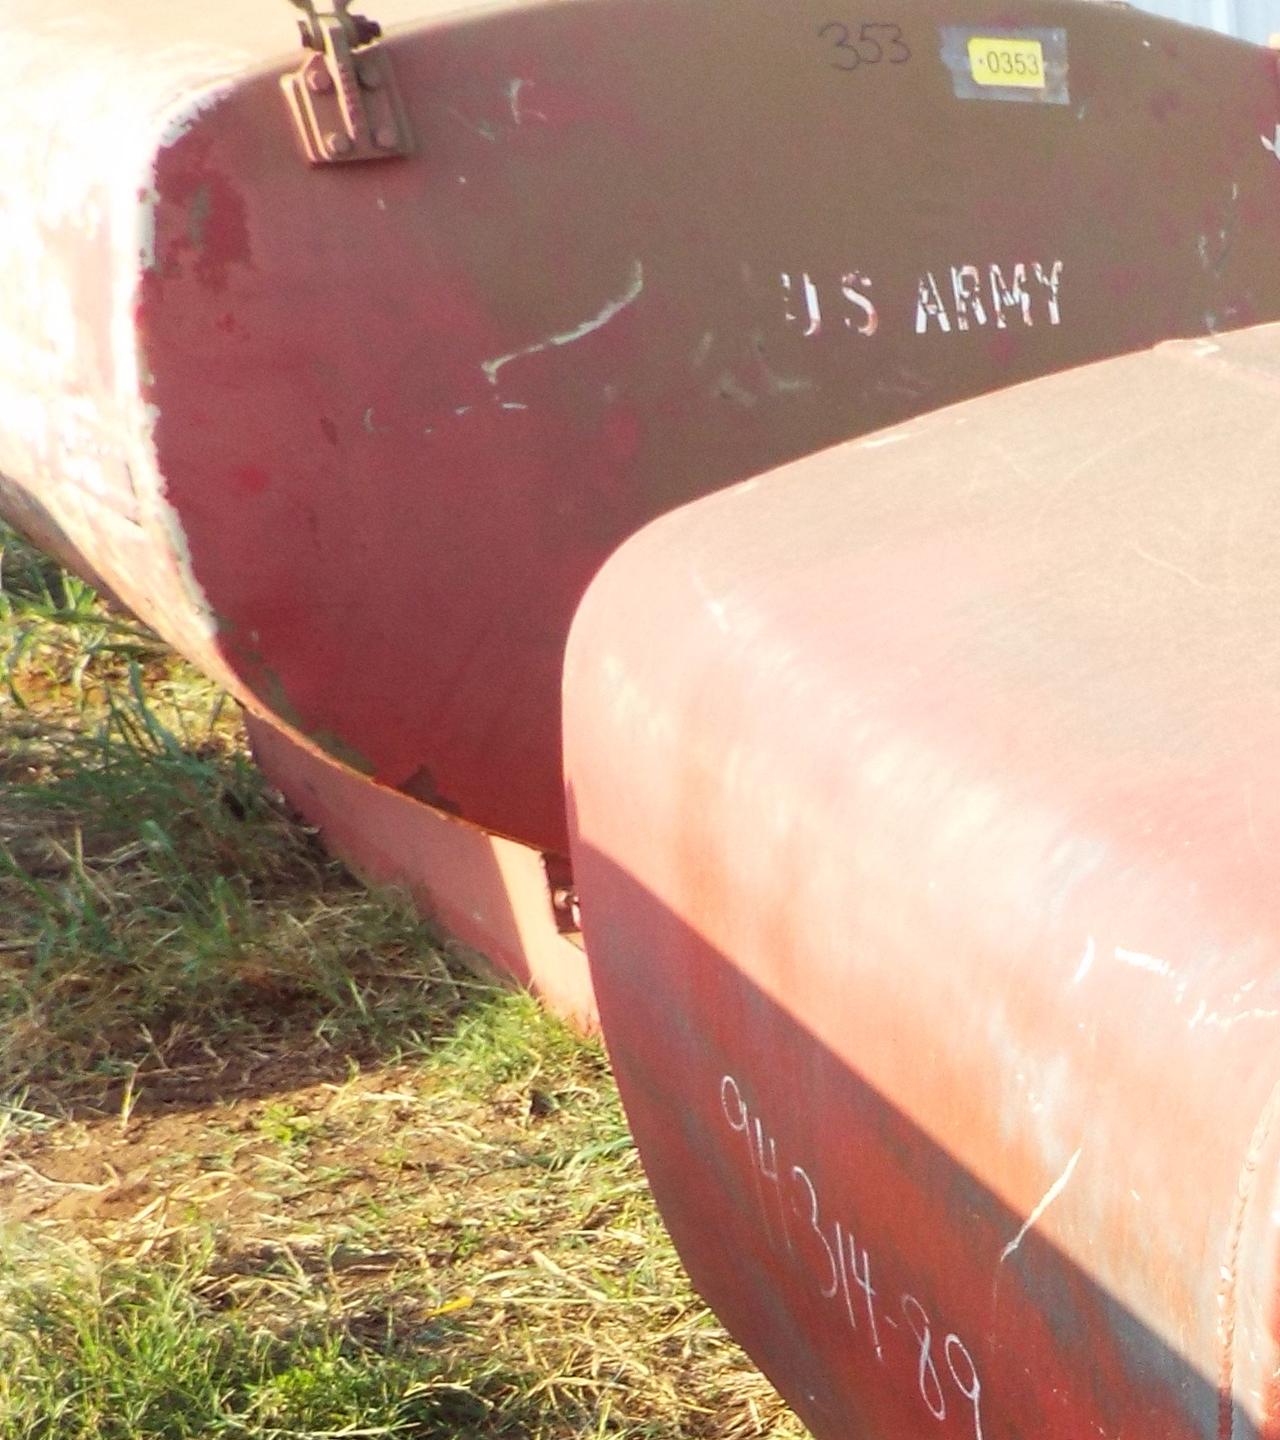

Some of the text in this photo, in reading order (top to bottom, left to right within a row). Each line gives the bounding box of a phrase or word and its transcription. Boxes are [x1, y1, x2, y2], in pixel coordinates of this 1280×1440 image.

[817, 22, 911, 71] 353
[986, 50, 1040, 76] 0353
[916, 259, 1064, 335] ARMY
